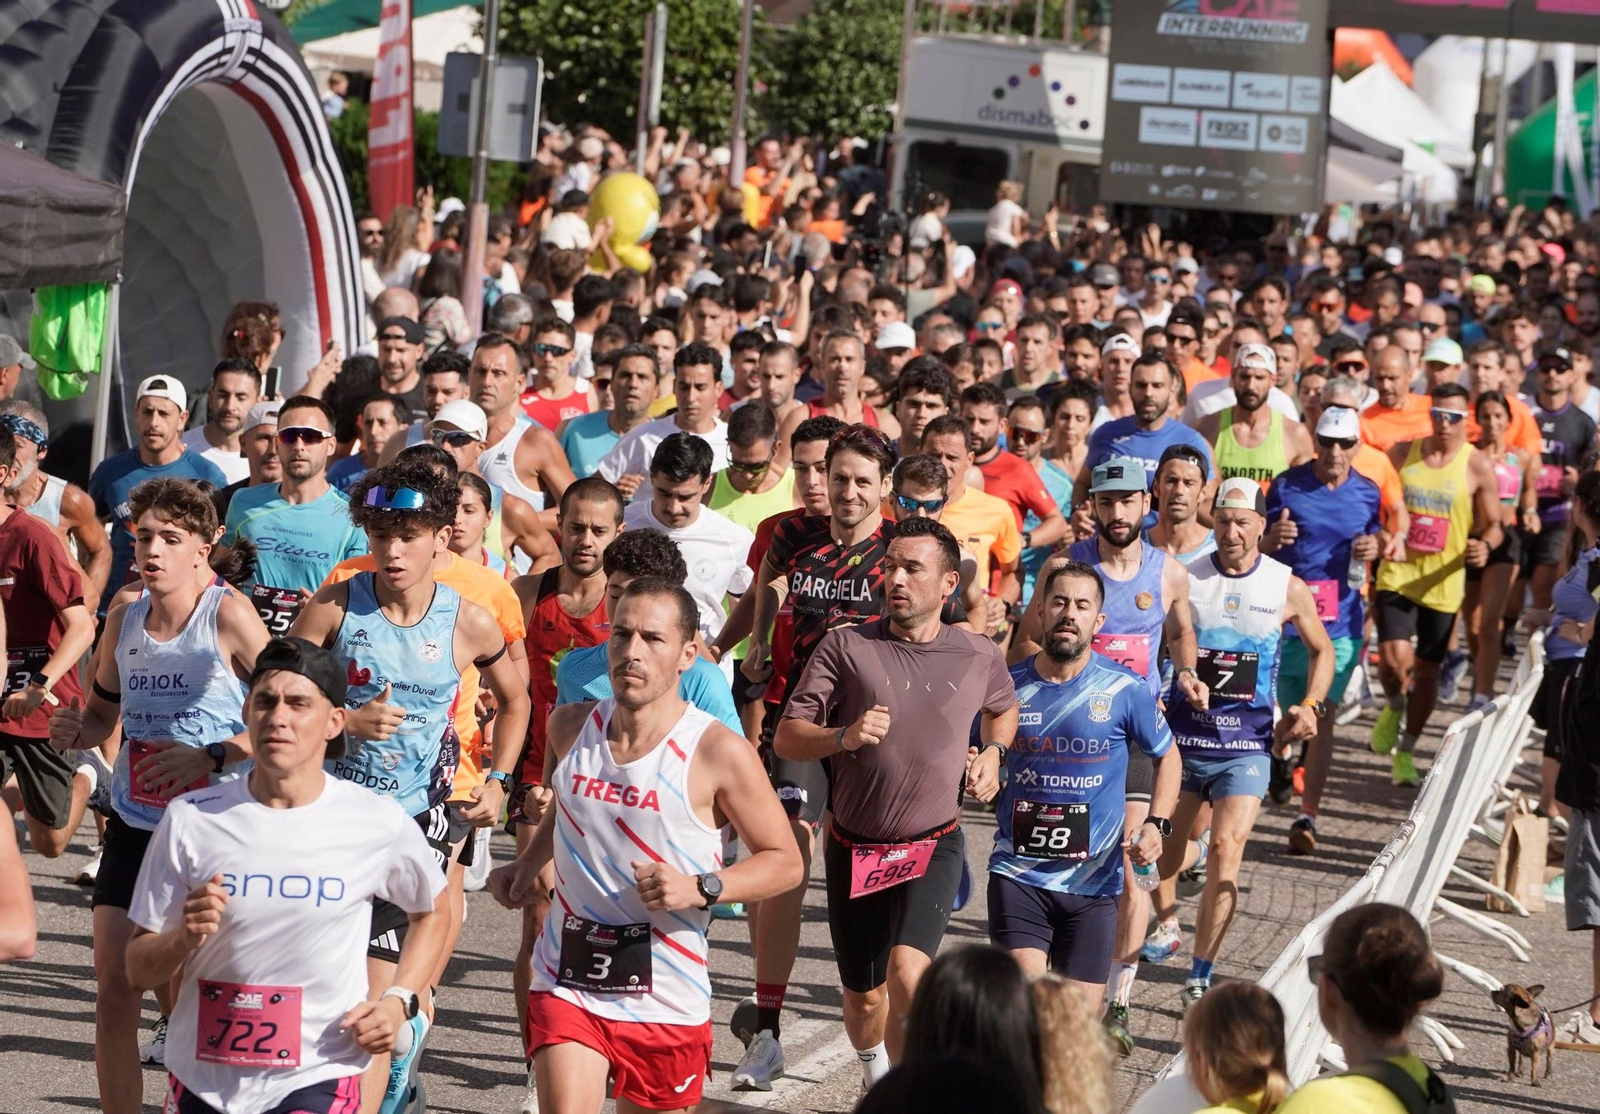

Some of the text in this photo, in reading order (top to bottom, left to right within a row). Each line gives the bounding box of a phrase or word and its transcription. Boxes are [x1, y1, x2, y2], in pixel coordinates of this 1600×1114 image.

[1163, 14, 1304, 42] INTERRUNNING
[255, 537, 330, 560] Eliseo
[791, 571, 872, 602] BARGIELA
[412, 684, 437, 696] Duval
[1214, 670, 1234, 689] 7
[1191, 712, 1241, 726] MECADOBA
[345, 755, 371, 768] ENAULT
[334, 760, 400, 792] RODOSA
[1041, 774, 1103, 789] TORVIGO
[571, 774, 660, 812] TREGA
[1028, 826, 1072, 849] 58
[863, 860, 917, 889] 698
[586, 953, 612, 980] 3
[234, 992, 263, 1005] CAE
[215, 1018, 278, 1054] 722
